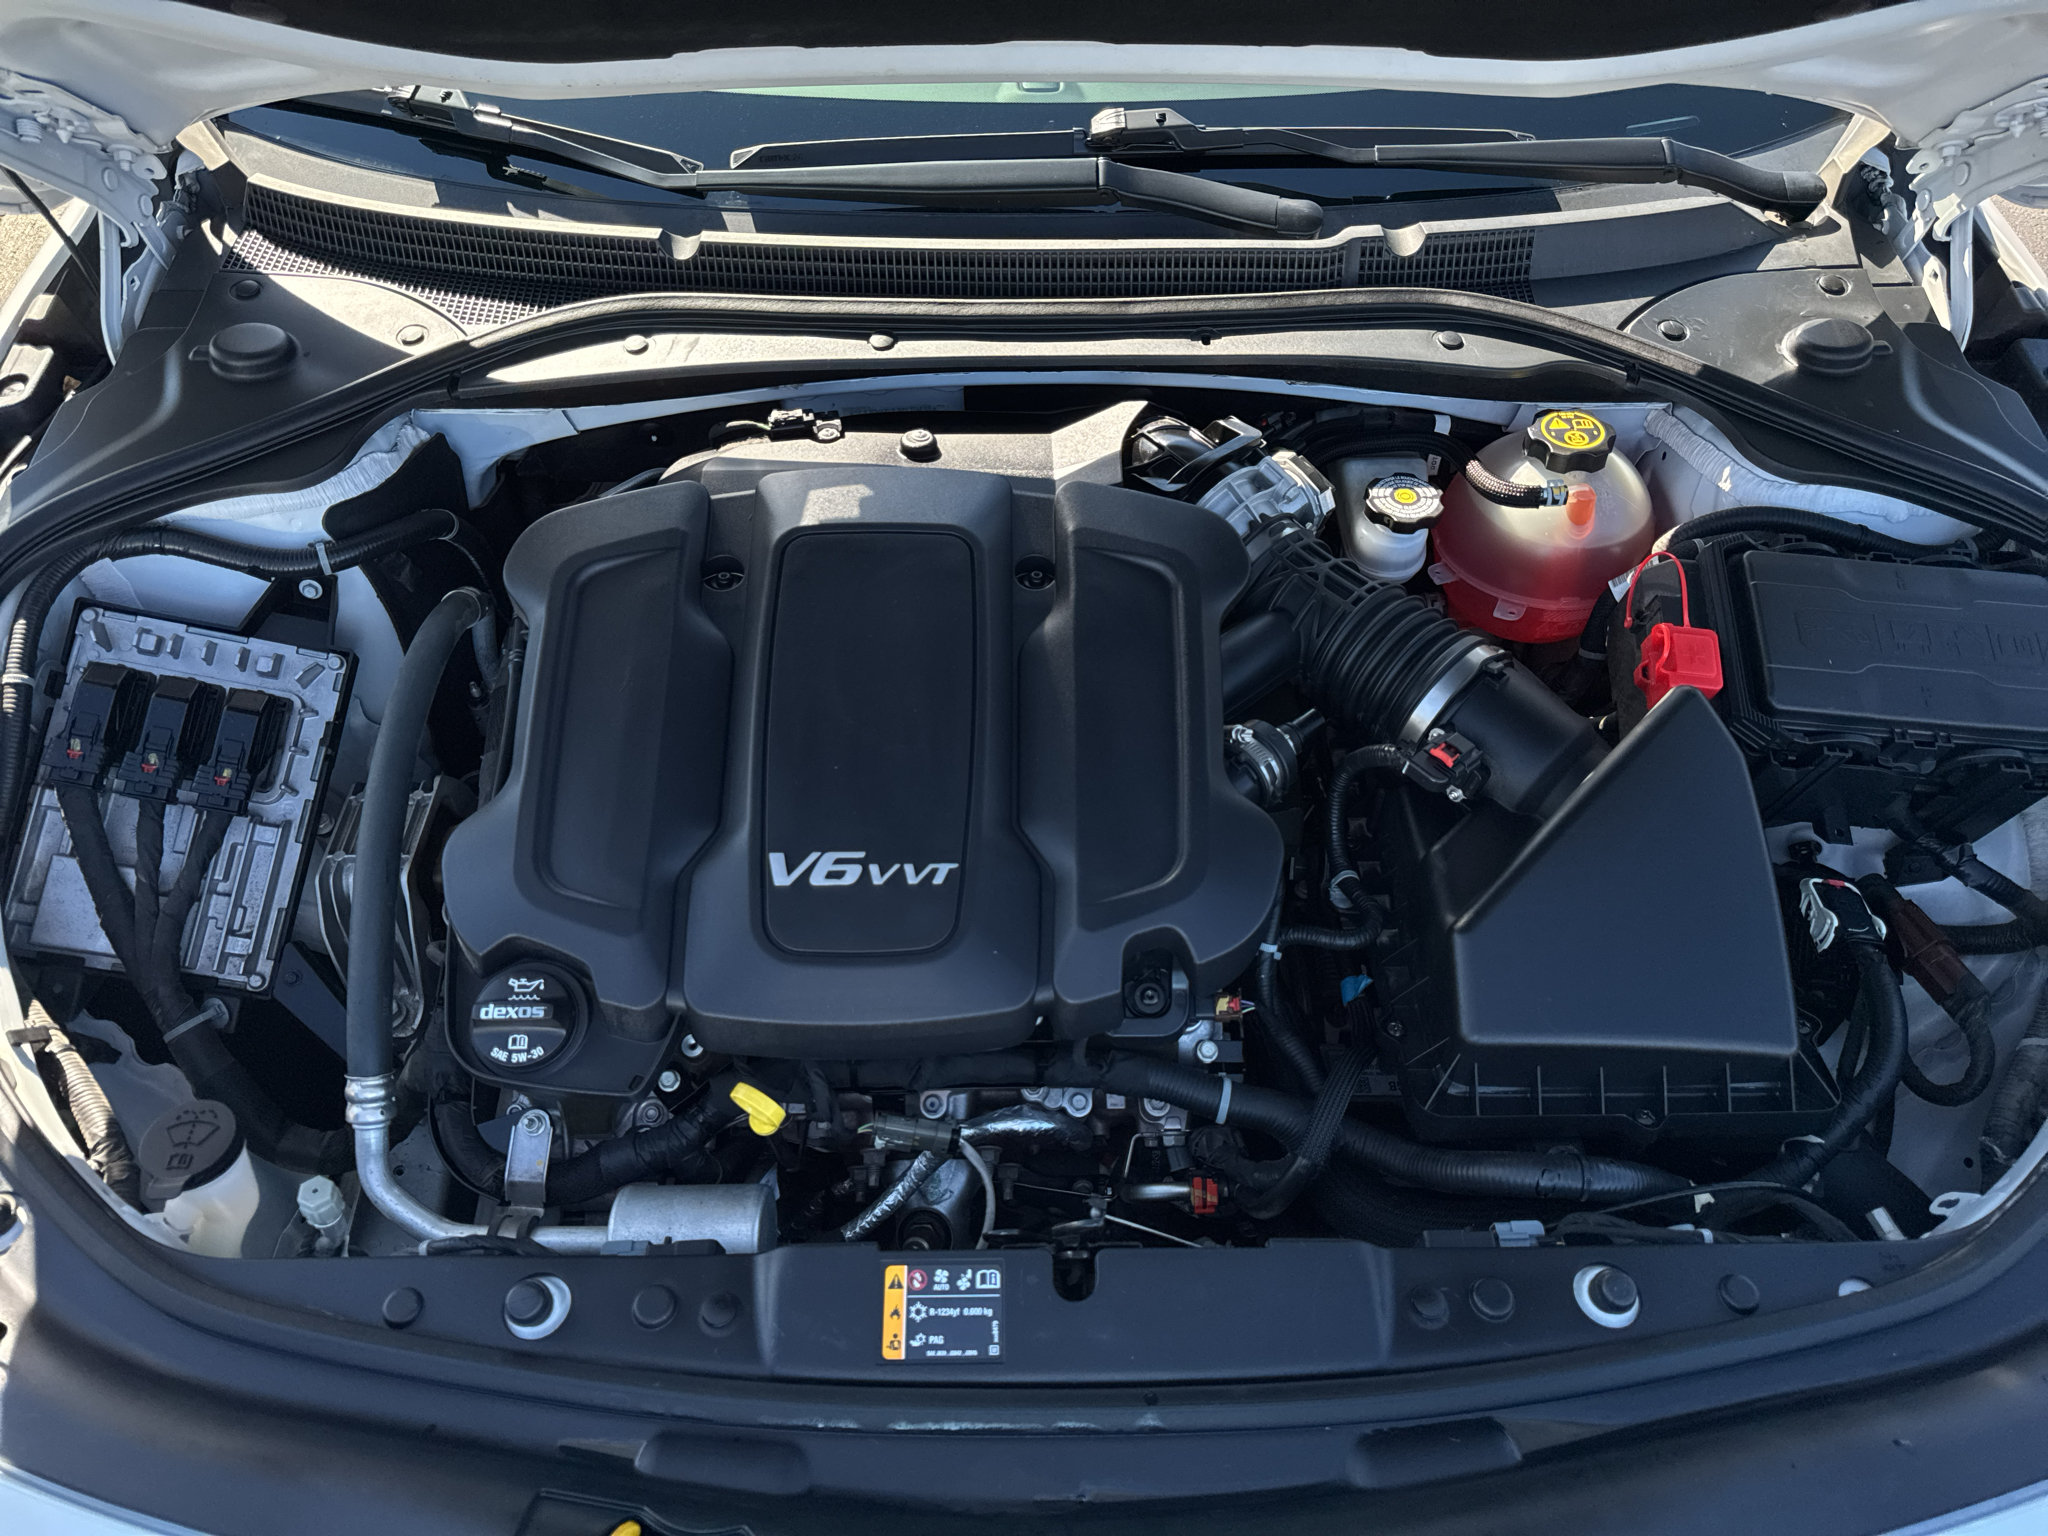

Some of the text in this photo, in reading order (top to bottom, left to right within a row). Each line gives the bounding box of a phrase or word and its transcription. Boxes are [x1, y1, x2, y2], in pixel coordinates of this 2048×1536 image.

[769, 851, 959, 886] V6 VVT
[480, 1003, 545, 1020] dexos
[490, 1046, 544, 1063] SAE 5W-30
[929, 1307, 961, 1317] R-1234yf
[929, 1335, 944, 1344] PAG
